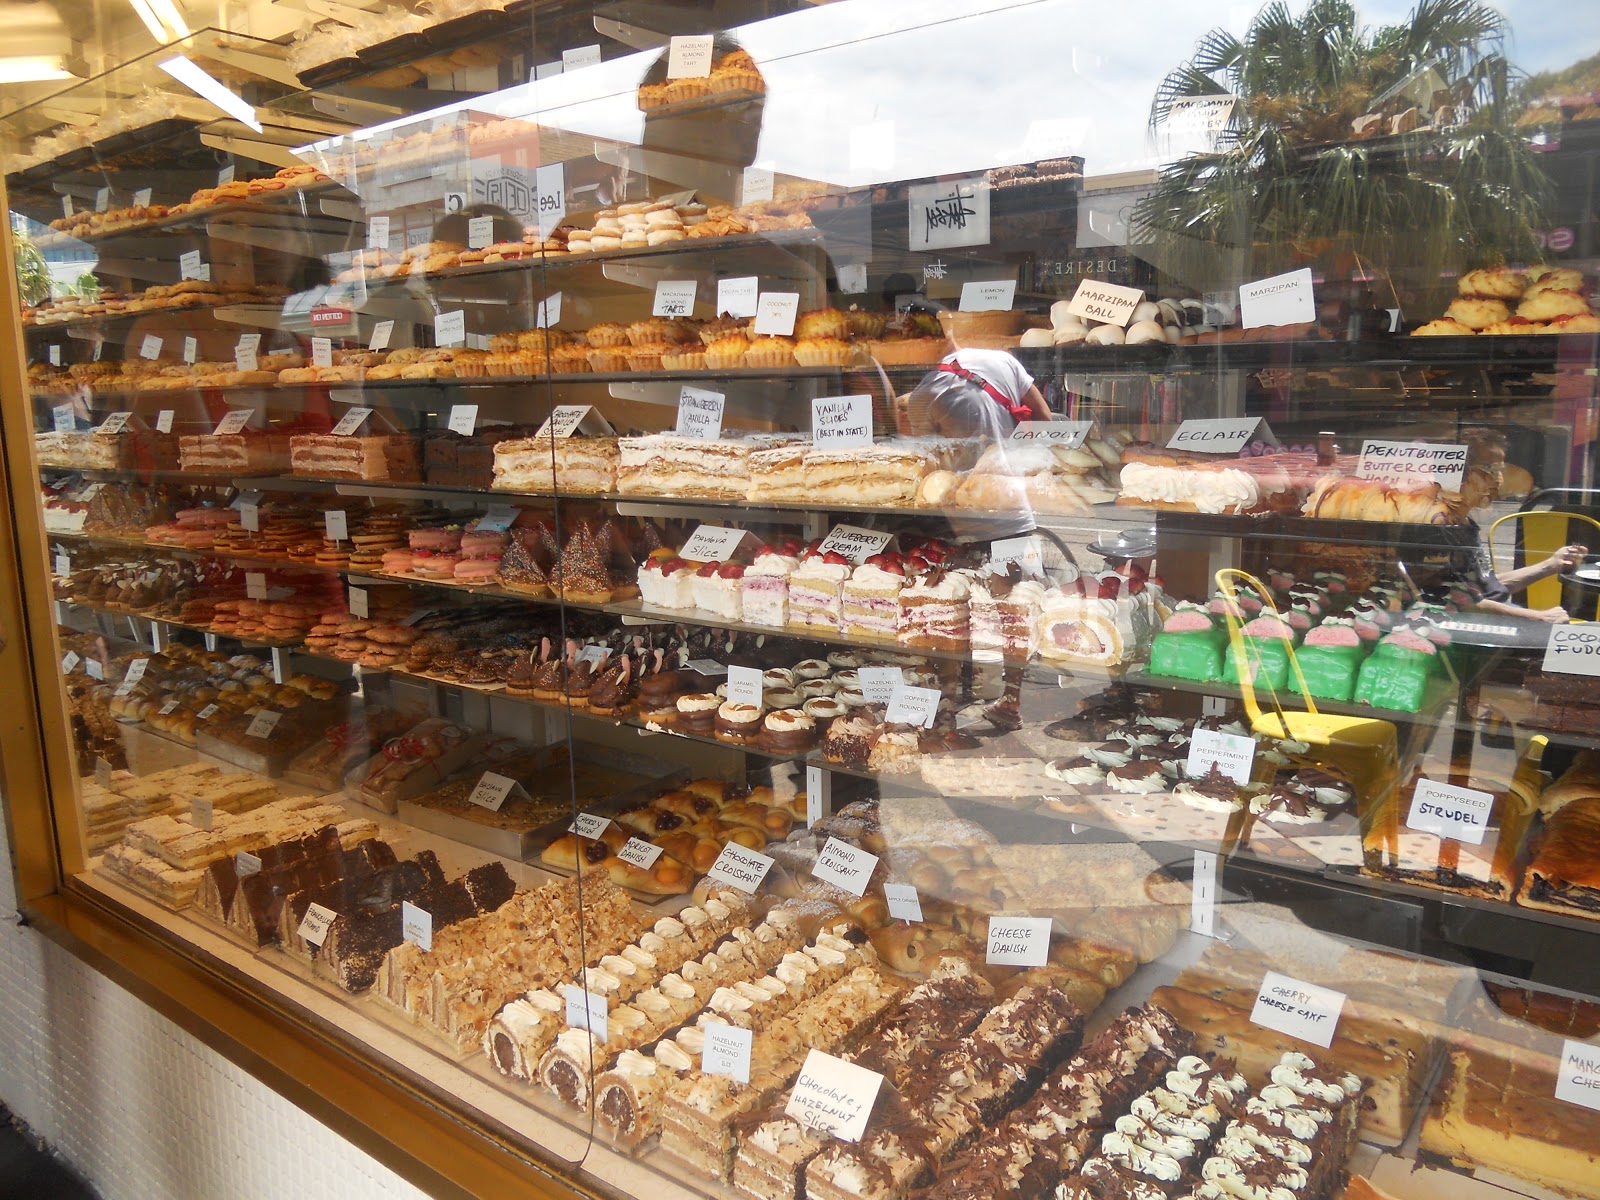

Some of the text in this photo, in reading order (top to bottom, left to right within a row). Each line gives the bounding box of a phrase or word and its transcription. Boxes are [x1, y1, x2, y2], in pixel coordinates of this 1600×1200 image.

[1250, 281, 1299, 298] MARZIPAN
[766, 300, 793, 308] COCONUT
[1080, 289, 1137, 309] MARZIPAN
[1085, 303, 1116, 319] BALL
[681, 391, 722, 423] STRAWBERRY
[816, 402, 853, 416] VANILLA
[820, 411, 849, 426] SLICES
[816, 425, 868, 441] (BEST IN STATE)
[1013, 431, 1081, 440] CANOLI
[1177, 430, 1249, 442] ECLAIR
[1363, 459, 1417, 473] BUTTER
[830, 527, 888, 551] BLUEBERRY
[823, 540, 862, 554] CREAM
[1554, 630, 1600, 643] COCO
[733, 680, 755, 688] CARAMEL
[904, 694, 929, 704] COFFEE
[899, 703, 926, 713] ROUNDS
[1196, 747, 1249, 761] PEPPERMINT
[1426, 790, 1487, 809] POPPYSEED
[1419, 802, 1479, 825] STRUDEL
[577, 815, 603, 829] CHERRY
[627, 840, 653, 855] APRICOT
[825, 843, 856, 863] ALMOND
[621, 849, 647, 863] DANISH
[722, 848, 766, 872] CHOCOLATE
[715, 861, 763, 884] CROISSANT
[820, 855, 860, 877] CROISSANT
[991, 926, 1033, 939] CHEESE
[992, 941, 1028, 954] DANISH
[1271, 985, 1312, 1005] CHERRY
[1259, 994, 1296, 1014] CHEESE
[712, 1035, 744, 1049] HAZELNUT
[712, 1045, 739, 1058] ALMOND
[794, 1094, 856, 1123] HAZELNUT
